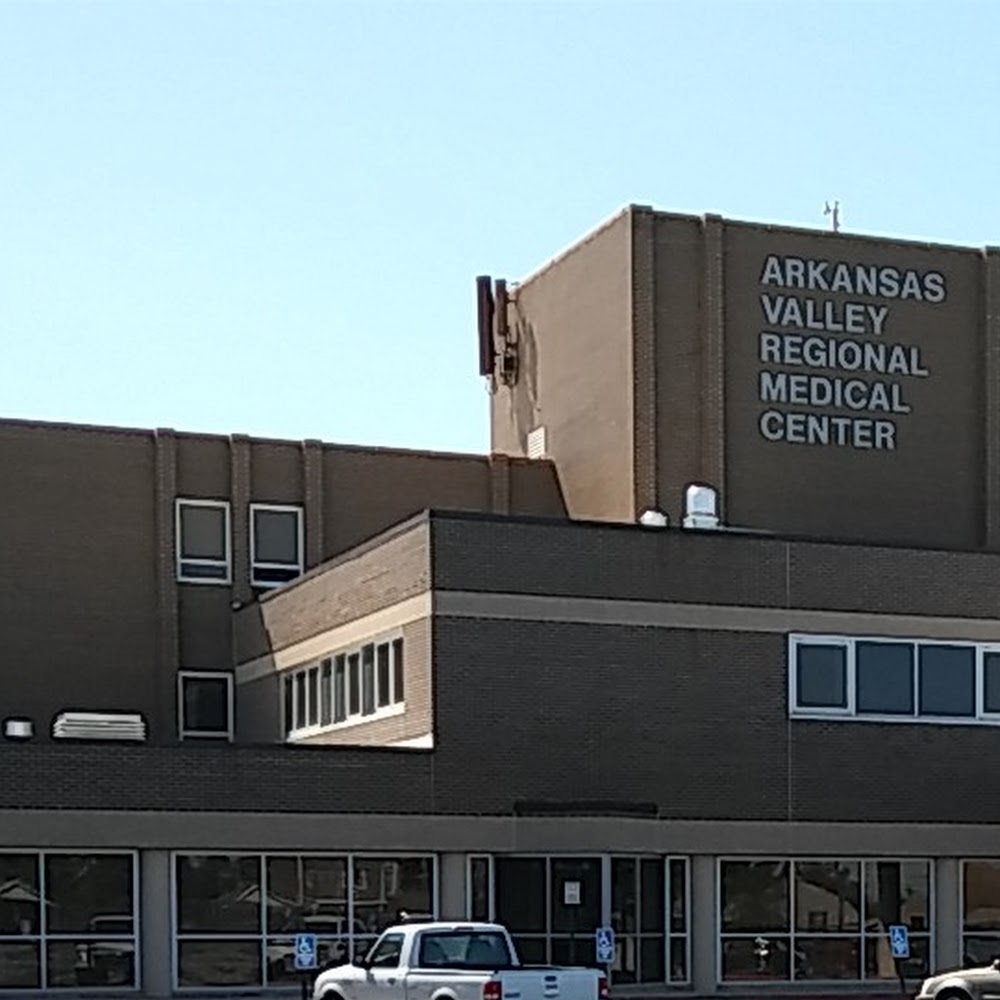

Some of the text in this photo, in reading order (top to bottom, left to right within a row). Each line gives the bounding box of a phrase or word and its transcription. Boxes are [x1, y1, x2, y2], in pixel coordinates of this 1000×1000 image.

[761, 256, 946, 302] ARKANSAS
[760, 294, 888, 335] VALLEY
[759, 332, 929, 376] REGIONAL
[759, 371, 911, 413] MEDICAL
[759, 410, 896, 450] CENTER
